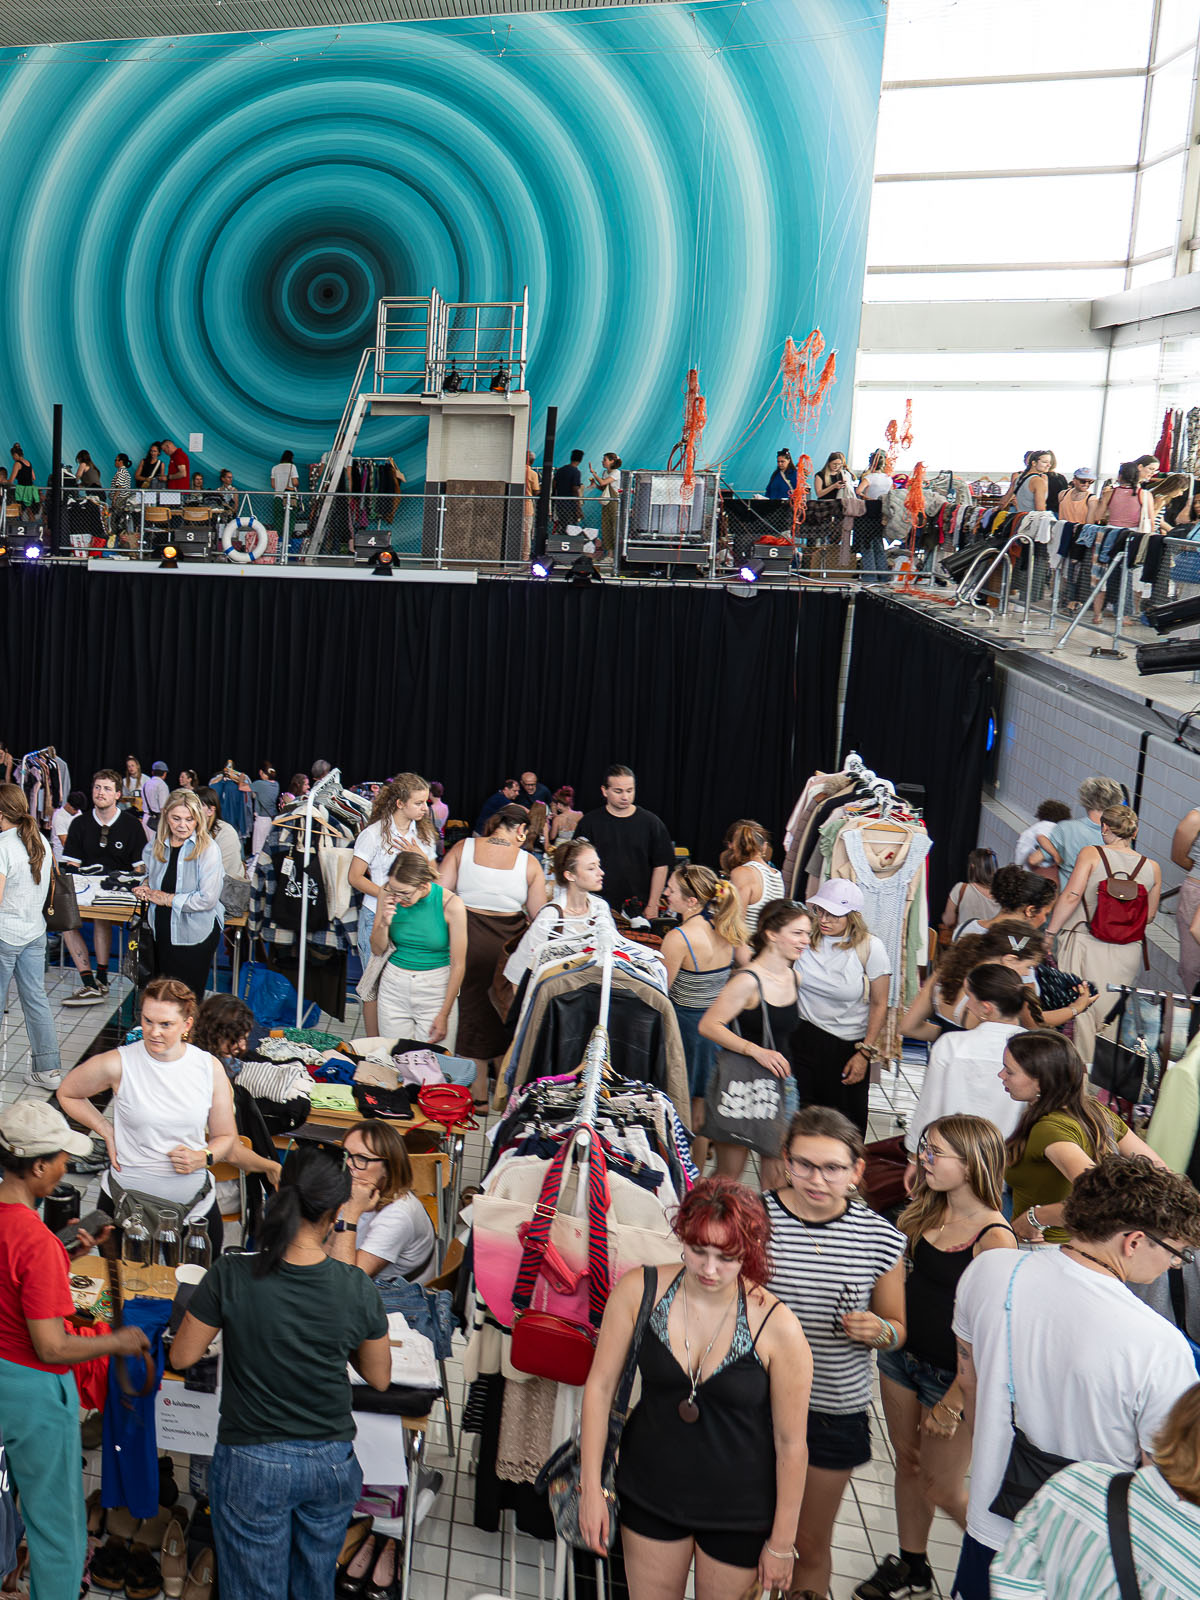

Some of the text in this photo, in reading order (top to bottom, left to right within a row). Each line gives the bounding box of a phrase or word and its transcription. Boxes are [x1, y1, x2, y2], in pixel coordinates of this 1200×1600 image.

[17, 526, 25, 536] 2
[186, 532, 195, 541] 3
[367, 536, 377, 546] 4
[561, 541, 570, 551] 5
[768, 548, 778, 557] 6
[172, 1400, 200, 1409] lululemon
